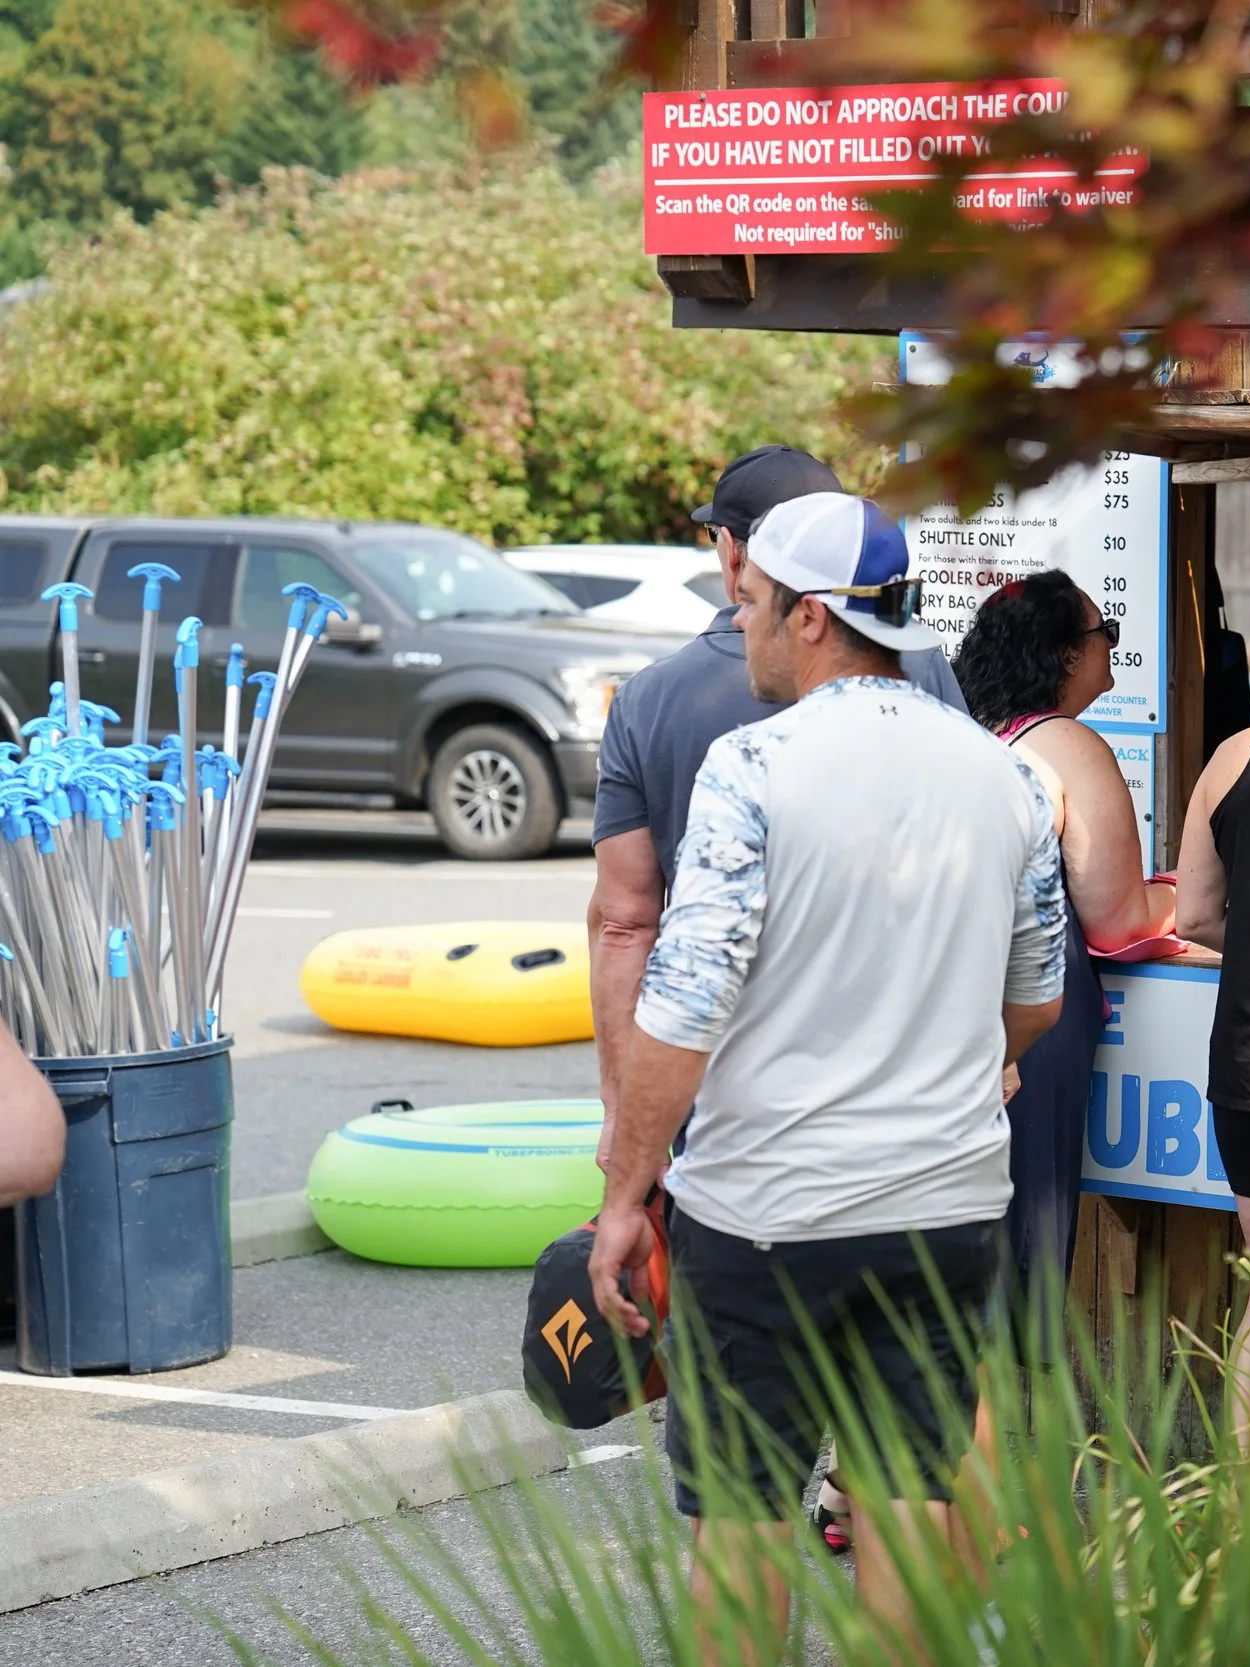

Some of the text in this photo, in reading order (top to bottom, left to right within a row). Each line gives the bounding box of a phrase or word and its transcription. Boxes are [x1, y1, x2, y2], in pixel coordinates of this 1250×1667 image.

[665, 102, 742, 128] PLEASE
[747, 101, 781, 127] DO
[785, 100, 833, 125] NOT
[836, 95, 958, 124] APPROACH
[963, 93, 1008, 119] THE
[651, 143, 670, 167] IF
[674, 141, 720, 167] YOU
[725, 140, 783, 166] HAVE
[787, 139, 835, 165] NOT
[839, 136, 912, 163] FILLED
[917, 135, 967, 162] OUT
[656, 195, 693, 214] Scan
[696, 193, 722, 213] the
[725, 193, 750, 215] QR
[753, 192, 792, 213] code
[795, 196, 817, 212] on
[820, 192, 847, 212] the
[953, 188, 984, 208] ard
[987, 188, 1013, 208] for
[1016, 186, 1048, 208] link
[1075, 185, 1134, 206] waiver
[734, 221, 910, 247] Not required for "shu
[1104, 469, 1129, 486] $35
[1104, 492, 1129, 510] $75
[919, 514, 936, 524] Two
[965, 516, 982, 526] and
[984, 517, 1000, 526] two
[1002, 517, 1019, 527] kids
[1021, 517, 1046, 527] under
[1048, 518, 1058, 528] 18
[919, 530, 1016, 547] SHUTTLE ONLY
[1103, 534, 1127, 552] $10
[918, 552, 1045, 568] For those with their own tubes
[918, 569, 974, 586] COOLER
[1103, 575, 1127, 593] $10
[948, 594, 977, 610] BAG
[1103, 600, 1127, 618] $10
[1111, 695, 1148, 706] COUNTER
[1112, 746, 1150, 762] ACK
[1125, 779, 1144, 789] EES:
